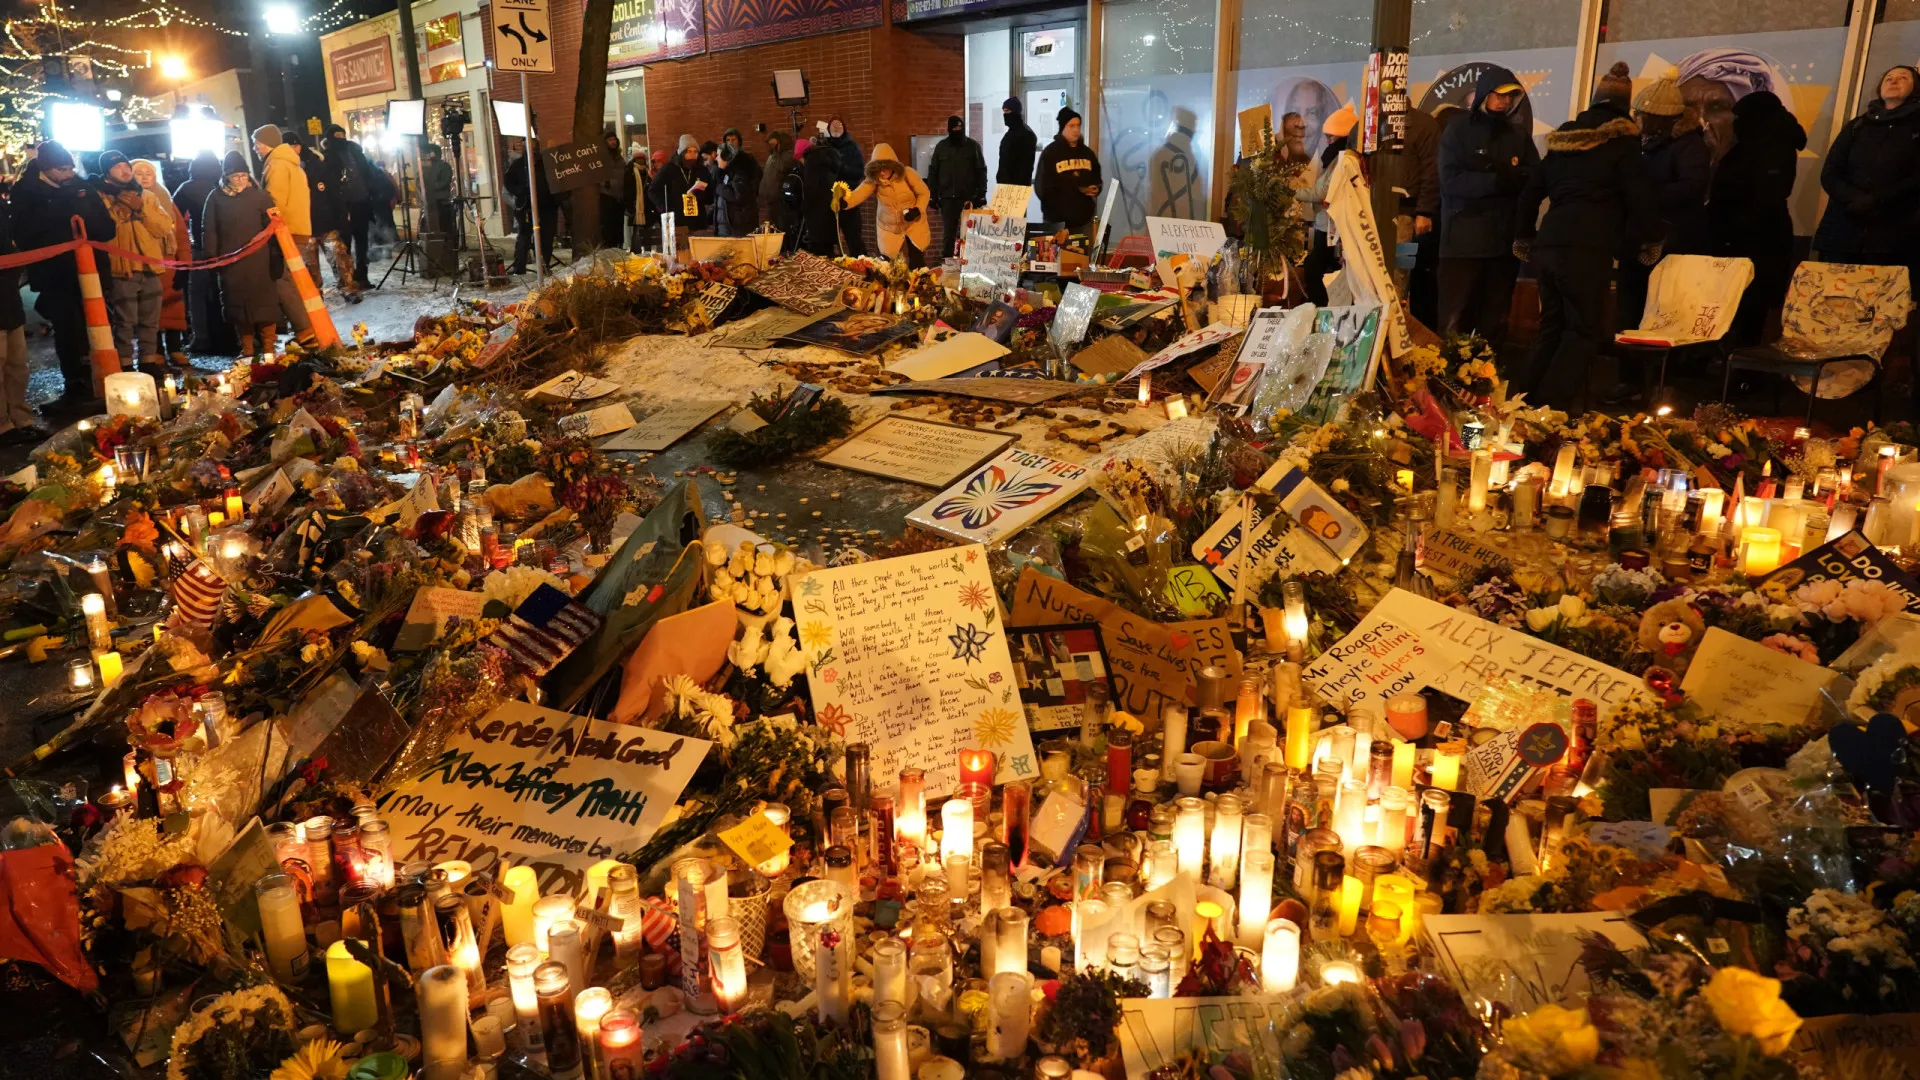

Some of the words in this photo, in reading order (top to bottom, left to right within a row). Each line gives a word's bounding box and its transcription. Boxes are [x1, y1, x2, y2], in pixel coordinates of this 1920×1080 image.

[612, 0, 646, 22] COLLET
[511, 58, 538, 67] ONLY
[550, 151, 572, 164] You
[576, 143, 598, 158] can't
[554, 163, 583, 180] break
[588, 160, 603, 170] us
[686, 195, 695, 216] PRESS
[973, 216, 1000, 237] Nurse
[1001, 217, 1025, 238] Alex
[1176, 242, 1198, 254] LOVE
[780, 283, 815, 299] NOT
[797, 265, 839, 288] YOUR
[898, 423, 928, 433] STRONG
[933, 428, 988, 442] COURAGEOUS
[1003, 449, 1087, 481] TOGETHER
[1221, 530, 1240, 549] VA
[1429, 530, 1441, 543] A
[1441, 532, 1473, 554] TRUE
[1473, 546, 1509, 567] HERO
[832, 580, 845, 594] All
[851, 576, 868, 587] these
[874, 571, 893, 585] people
[910, 564, 921, 574] the
[928, 558, 949, 571] world
[1446, 556, 1460, 569] IN
[1816, 552, 1857, 587] LOV
[1850, 555, 1882, 579] DO
[833, 593, 853, 604] Going
[871, 584, 888, 594] with
[895, 578, 912, 589] their
[919, 573, 935, 581] lives
[862, 596, 877, 607] they
[882, 592, 897, 609] just
[901, 584, 930, 597] murdered
[943, 579, 959, 587] man
[1026, 579, 1103, 626] Nurse
[850, 608, 866, 618] front
[874, 604, 882, 612] of
[891, 600, 902, 608] my
[907, 594, 925, 606] eyes
[839, 627, 855, 639] Will
[864, 619, 897, 633] somebody
[904, 613, 916, 622] tell
[924, 608, 944, 617] them
[840, 638, 855, 648] Will
[861, 634, 877, 645] they
[881, 627, 903, 638] watch
[921, 616, 952, 629] someday
[1427, 616, 1503, 655] ALEX
[842, 647, 858, 658] Will
[863, 643, 877, 653] they
[881, 638, 895, 648] also
[900, 634, 912, 648] get
[930, 627, 943, 635] see
[845, 655, 862, 665] What
[877, 644, 909, 656] witnessed
[918, 635, 939, 647] today
[849, 681, 863, 690] And
[880, 671, 898, 681] catch
[905, 665, 918, 673] fire
[1302, 663, 1335, 682] Mr.
[1317, 657, 1374, 700] They're
[1365, 644, 1426, 686] helpers
[850, 689, 866, 700] Will
[873, 684, 884, 692] the
[891, 676, 911, 687] video
[917, 671, 925, 680] of
[1112, 673, 1177, 720] OUT
[1487, 740, 1504, 767] GOOD
[417, 747, 506, 790] Alex
[494, 761, 590, 815] Jeffrey
[454, 803, 514, 837] their
[510, 824, 588, 853] memories
[586, 836, 613, 858] be
